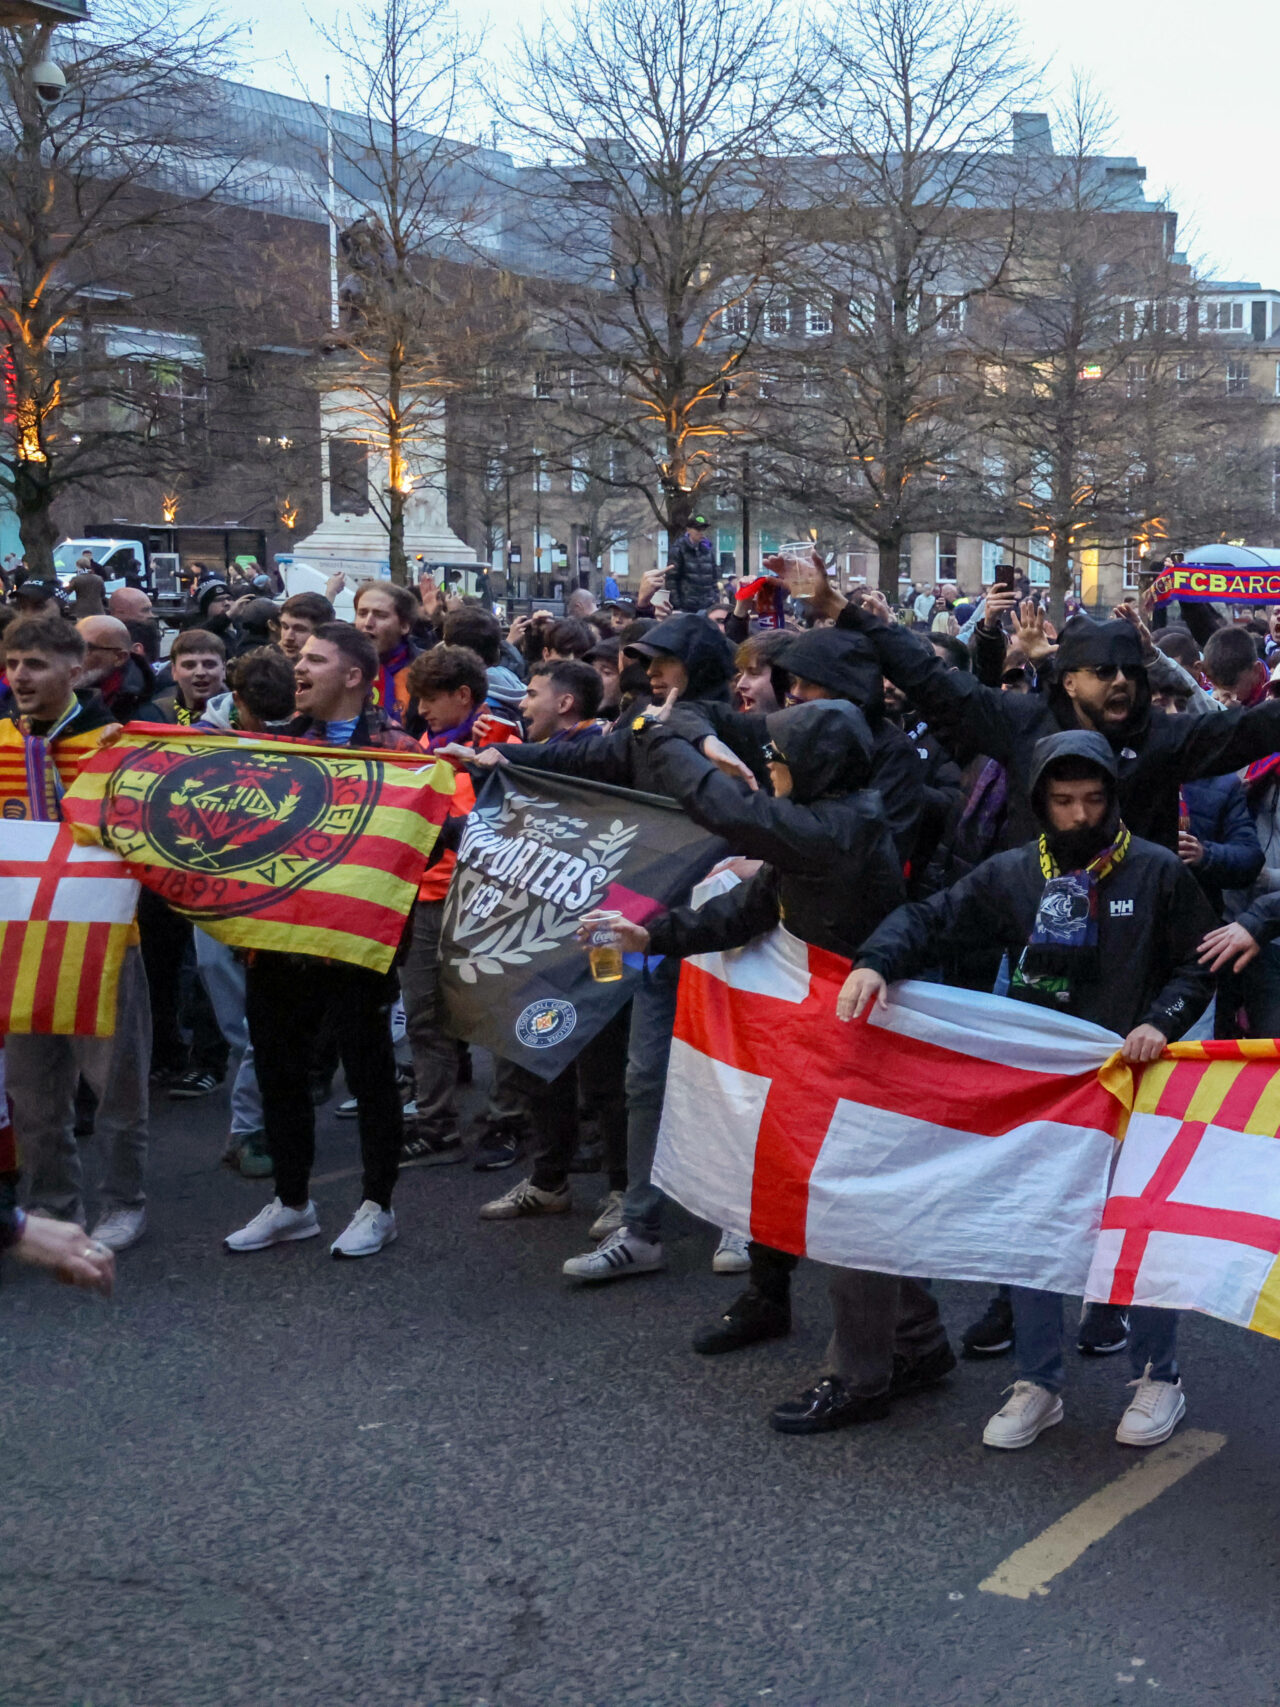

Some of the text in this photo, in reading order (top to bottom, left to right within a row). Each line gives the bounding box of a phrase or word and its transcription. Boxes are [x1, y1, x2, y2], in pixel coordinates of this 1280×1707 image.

[255, 757, 363, 885] ARCELONA
[159, 868, 230, 901] 1899
[465, 883, 504, 919] FCB
[1110, 899, 1134, 913] HH
